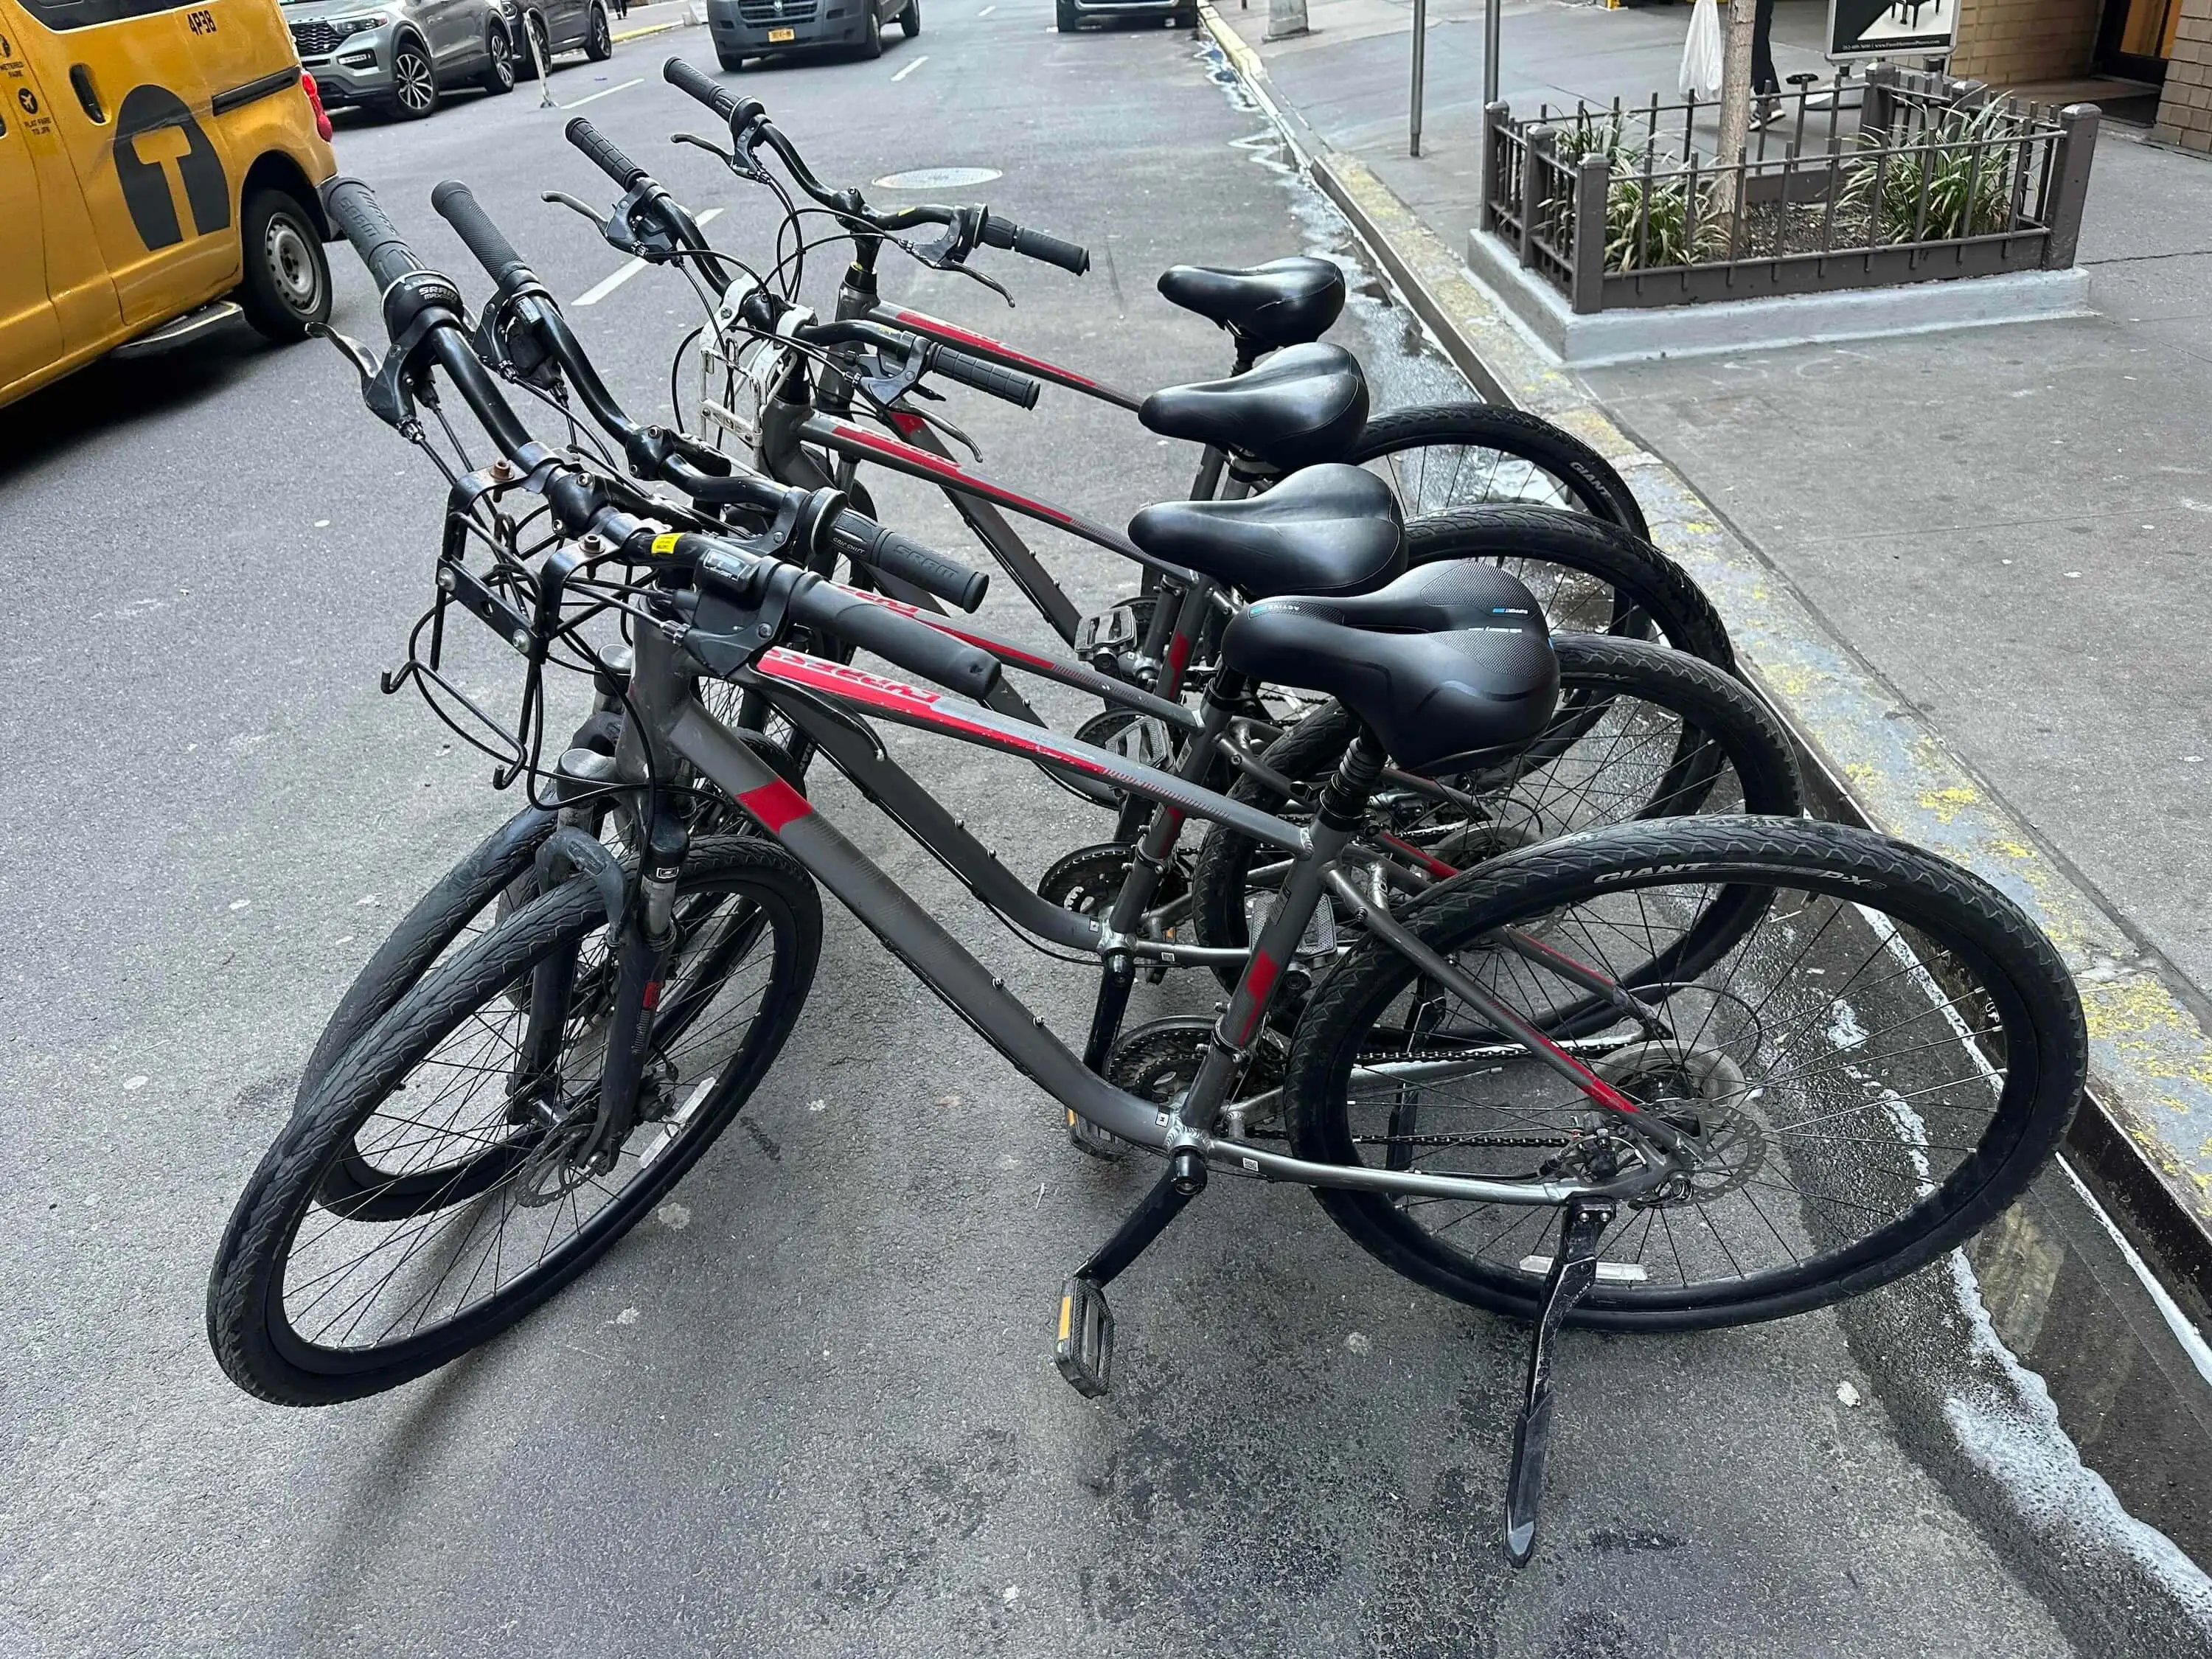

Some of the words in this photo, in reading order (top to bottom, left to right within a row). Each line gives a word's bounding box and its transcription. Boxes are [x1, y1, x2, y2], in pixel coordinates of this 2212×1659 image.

[131, 125, 199, 241] T
[1570, 462, 1612, 498] GIANT
[1593, 862, 1708, 884] GIANT
